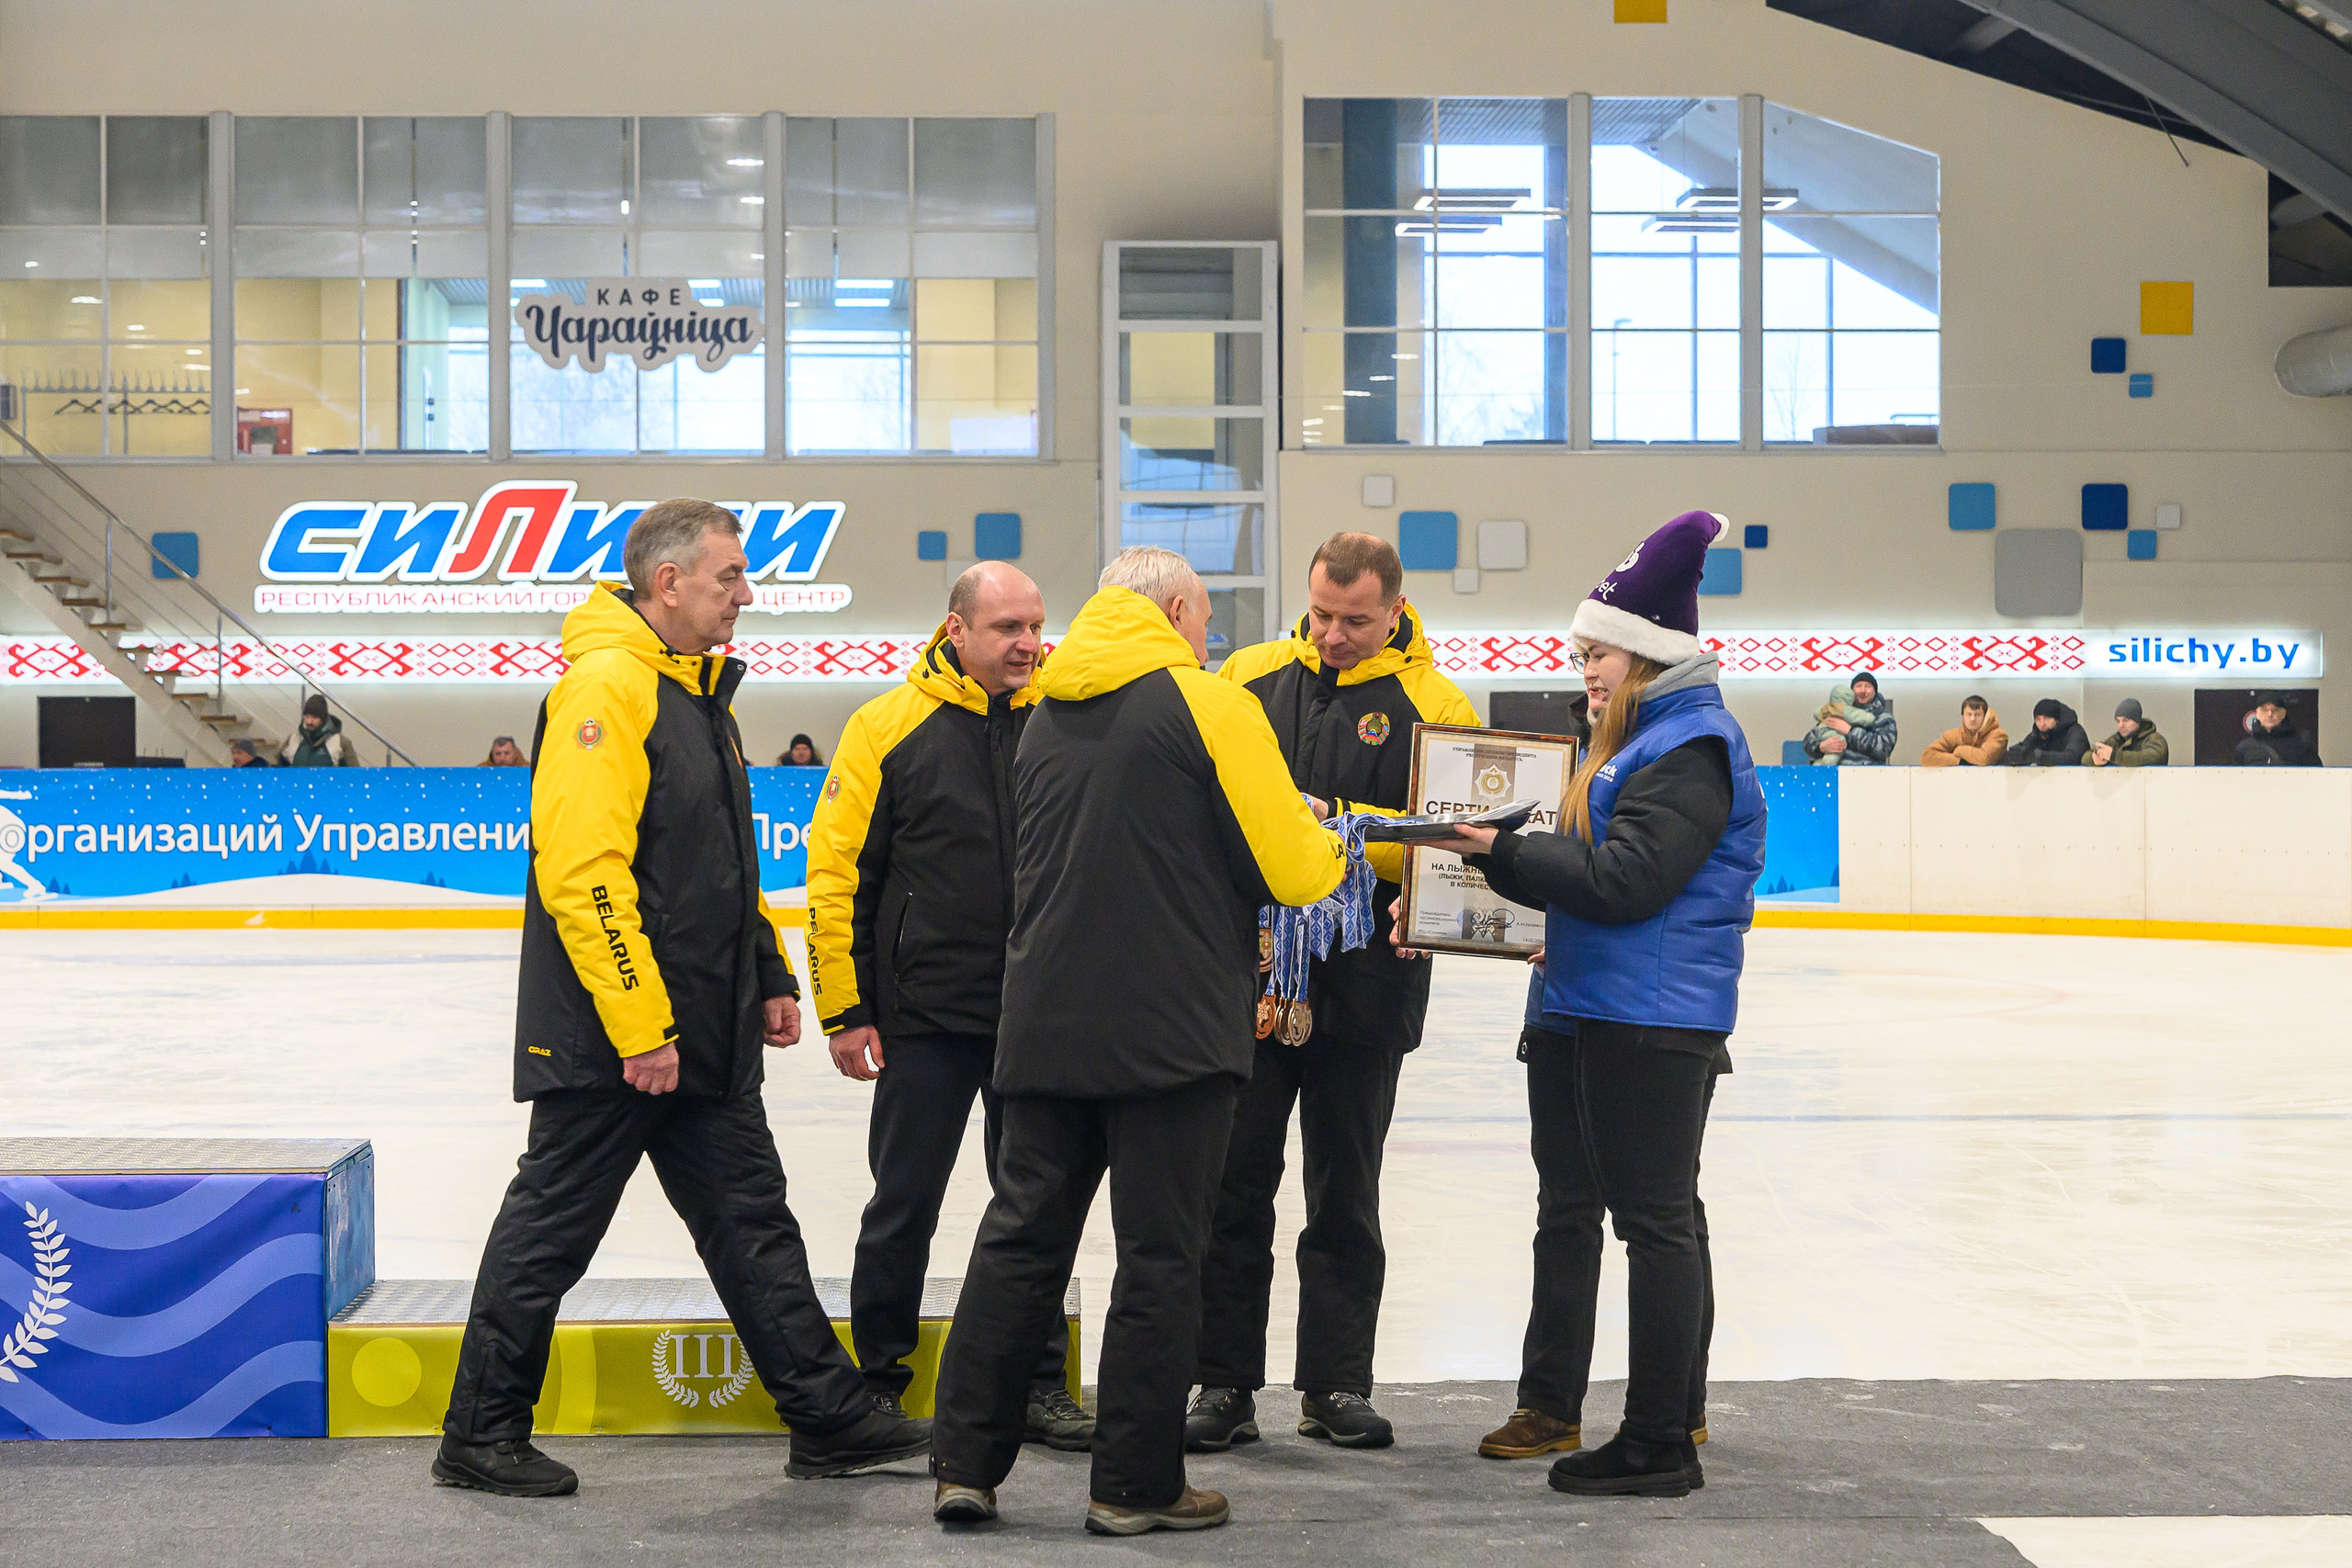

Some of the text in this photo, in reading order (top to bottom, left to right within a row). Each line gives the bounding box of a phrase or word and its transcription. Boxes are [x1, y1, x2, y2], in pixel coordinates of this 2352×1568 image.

[597, 288, 681, 306] КАФЕ
[526, 305, 753, 363] Чараўніца
[267, 488, 837, 573] СИЛИИ
[262, 587, 533, 606] РЕСПУБЛИКАНСКИЙ
[763, 592, 844, 608] ЦЕНТР
[2109, 637, 2300, 669] silichy.by
[1426, 800, 1557, 826] СЕРТИАТ
[0, 812, 812, 863] организаций Управлени Пре
[1431, 863, 1445, 872] НА
[1456, 882, 1491, 890] КОЛИЧЕС
[592, 885, 639, 991] BELARUS
[670, 1334, 738, 1378] III
